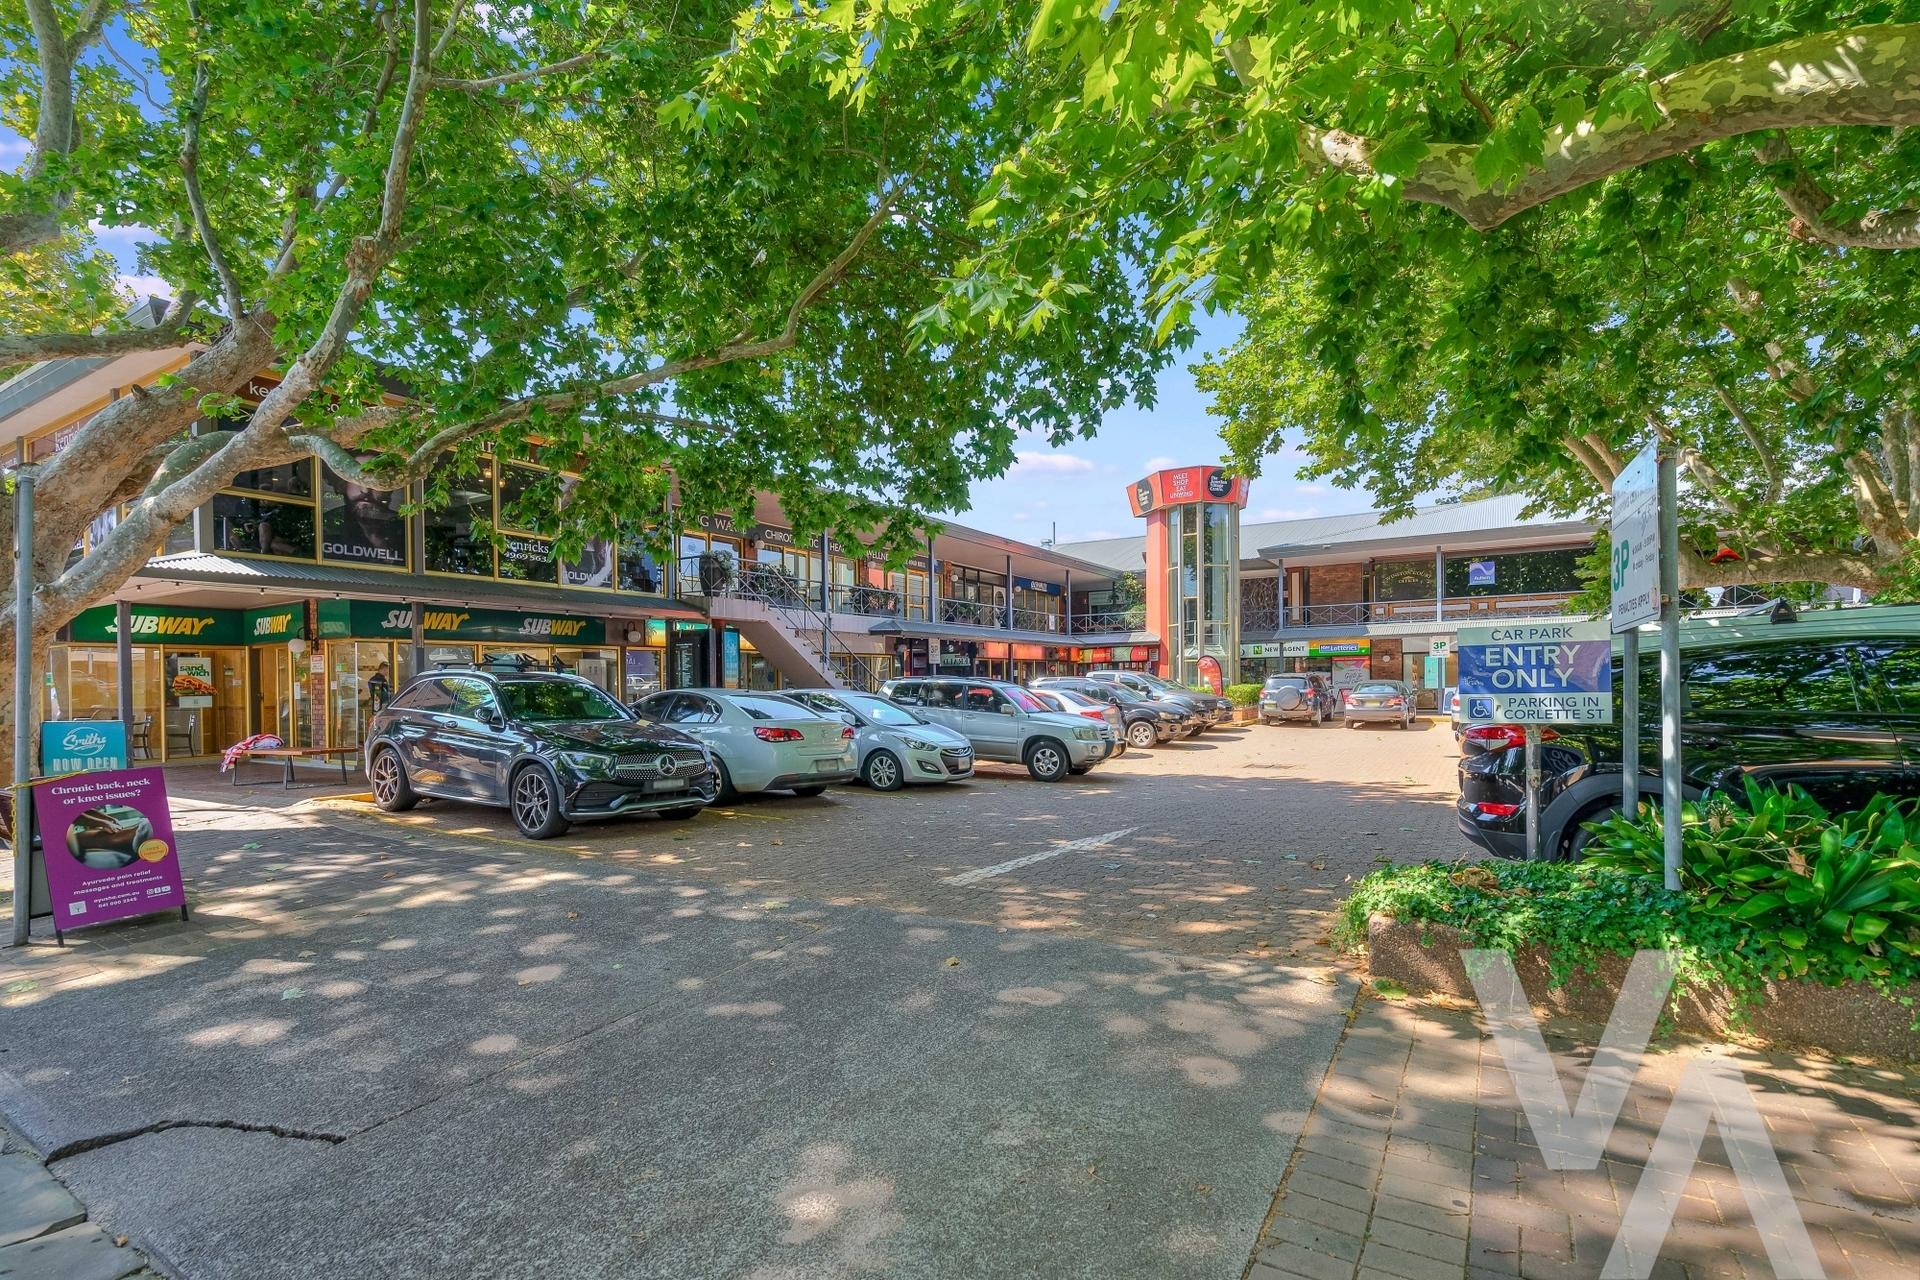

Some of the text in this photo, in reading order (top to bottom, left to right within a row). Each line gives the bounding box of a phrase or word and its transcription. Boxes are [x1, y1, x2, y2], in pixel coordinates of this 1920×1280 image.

[1172, 479, 1190, 487] SHOP
[1169, 490, 1194, 499] UNWIND
[322, 542, 404, 561] GOLDWELL
[1613, 539, 1630, 592] 3P
[1618, 592, 1650, 615] PENALTIES APPLY
[253, 612, 292, 636] SUBWAY
[381, 610, 470, 631] SUWAY
[519, 617, 587, 636] SUBWAY
[1491, 626, 1573, 641] CAR PARK
[1331, 643, 1358, 652] Lotteries
[1433, 641, 1447, 650] 3P
[1485, 644, 1581, 667] ENTRY
[179, 663, 204, 672] sand
[187, 669, 210, 677] wich
[1491, 667, 1574, 689] ONLY
[1508, 696, 1599, 708] PARKING IN
[1503, 708, 1605, 720] CORLETTE ST
[53, 756, 118, 771] NOW OPEN
[51, 778, 151, 795] Chronic back, neck
[78, 793, 104, 803] knee
[105, 788, 141, 800] issues?
[82, 869, 151, 886] Ayurveda pain relief
[126, 875, 163, 886] treatments
